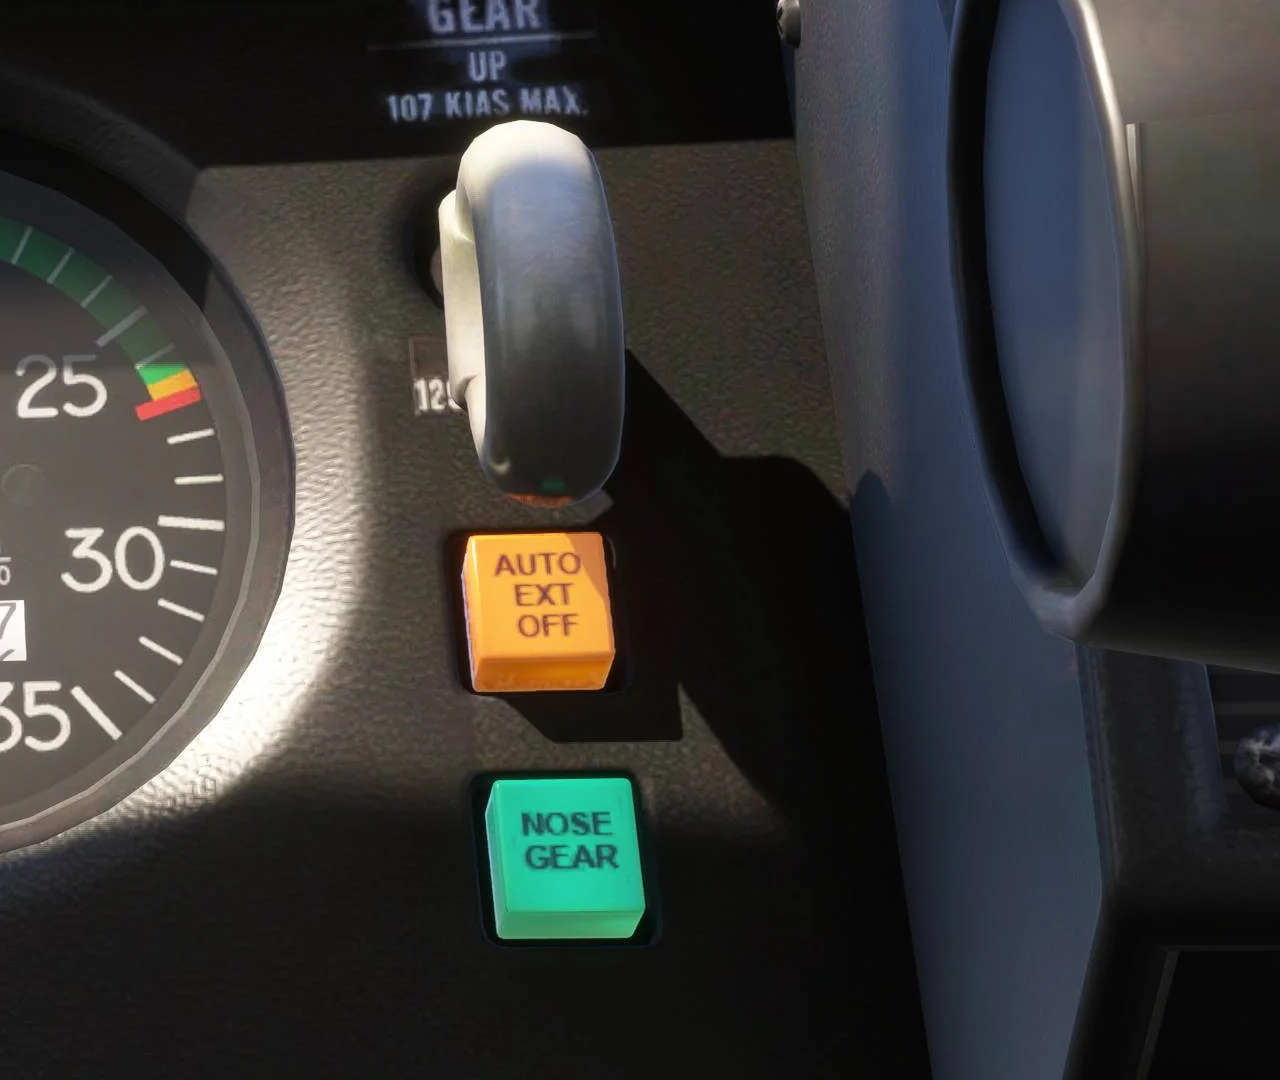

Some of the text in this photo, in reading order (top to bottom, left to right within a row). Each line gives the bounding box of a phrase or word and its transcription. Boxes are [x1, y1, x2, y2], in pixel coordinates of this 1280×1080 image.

[468, 50, 507, 83] UP
[387, 85, 589, 124] 107 KIAS MAX.
[15, 354, 108, 419] 25
[60, 525, 165, 594] 30
[494, 552, 583, 577] AUTO
[514, 583, 573, 608] EXT
[517, 613, 580, 639] OFF
[521, 810, 614, 838] NOSE
[524, 843, 620, 871] GEAR
